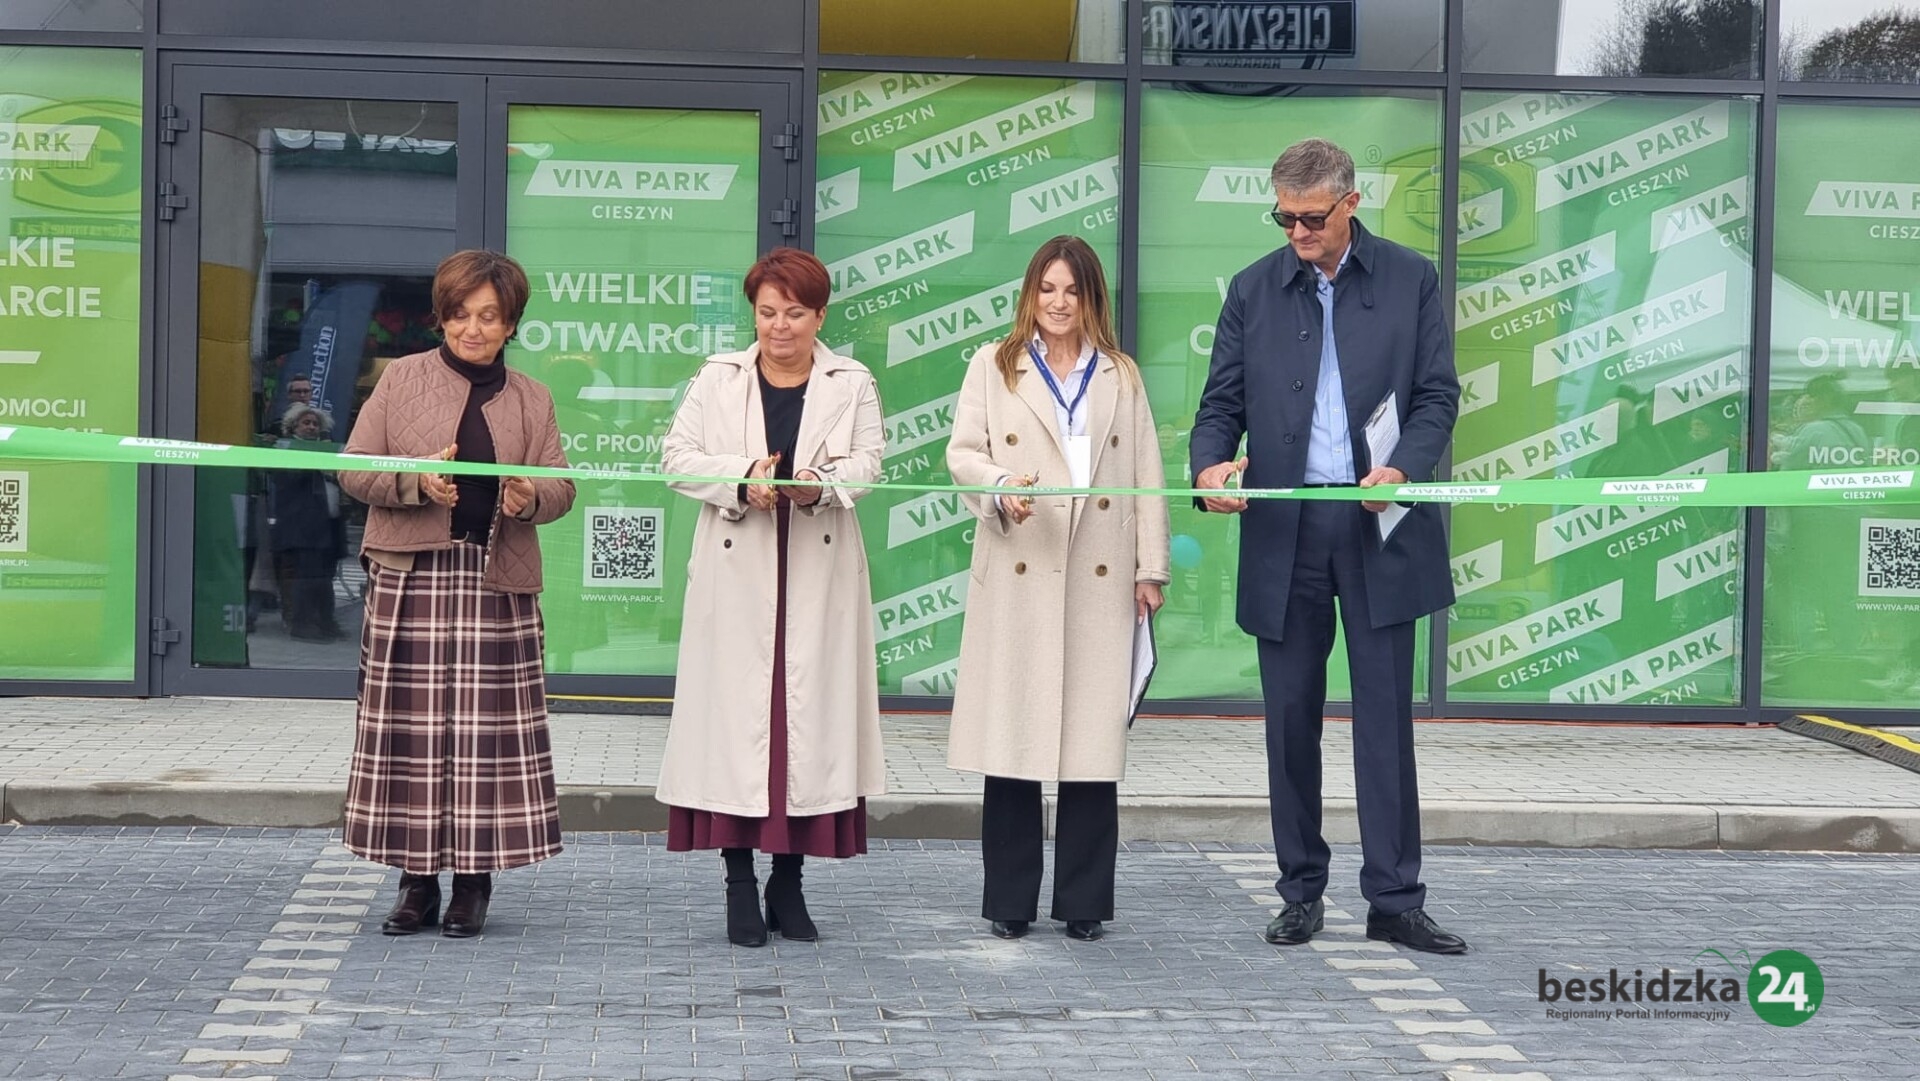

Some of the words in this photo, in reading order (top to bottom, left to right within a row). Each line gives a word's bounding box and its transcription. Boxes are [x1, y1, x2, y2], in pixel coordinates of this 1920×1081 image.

[820, 89, 873, 123] IVA
[880, 73, 951, 100] PAR
[851, 104, 937, 146] CIESZYN
[912, 130, 989, 170] VIVA
[996, 95, 1077, 141] PARK
[1462, 110, 1515, 145] IVA
[1493, 124, 1578, 167] CIESZYN
[967, 145, 1051, 187] CIESZYN
[1554, 150, 1629, 191] VIVA
[1636, 116, 1711, 161] PARK
[553, 169, 623, 189] VIVA
[635, 170, 711, 191] PARK
[1028, 173, 1105, 214] VIVA
[1224, 175, 1274, 195] VIV
[1608, 163, 1689, 207] CIESZYN
[1833, 188, 1900, 210] VIVA
[592, 204, 673, 221] CIESZYN
[1668, 191, 1741, 231] VIVA
[874, 230, 956, 275] PARK
[546, 272, 712, 305] WIELKIE
[844, 279, 930, 321] CIESZYN
[1458, 285, 1512, 319] IVA
[1519, 250, 1598, 295] PARK
[519, 320, 737, 354] OTWARCIE
[906, 307, 983, 347] VIVA
[1490, 298, 1573, 341] CIESZYN
[1551, 325, 1625, 366] VIVA
[1631, 289, 1709, 335] PARK
[1604, 339, 1685, 381] CIESZYN
[1671, 363, 1742, 404] VIVA
[154, 449, 199, 459] CIESZYN
[371, 460, 417, 469] CIESZYN
[1522, 421, 1601, 467] PARK
[1809, 446, 1865, 466] MOC
[1408, 487, 1444, 495] VIVA
[1449, 486, 1488, 494] PARK
[1612, 483, 1649, 492] VIVA
[1655, 482, 1695, 491] PARK
[1820, 476, 1856, 486] VIVA
[1863, 475, 1902, 485] PARK
[1843, 491, 1885, 499] CIESZYN
[906, 493, 968, 528] VIV
[1554, 505, 1627, 543] VIVA
[1607, 515, 1687, 558] CIESZYN
[581, 593, 665, 603] WWW.VIVA-PARK.PL
[878, 585, 960, 632] PARK
[877, 635, 933, 668] SZYN
[1448, 634, 1518, 673] VIVA
[1526, 598, 1605, 645] PARK
[1497, 646, 1580, 689] CIESZYN
[1567, 668, 1640, 704] VIVA
[1647, 632, 1722, 679] PARK
